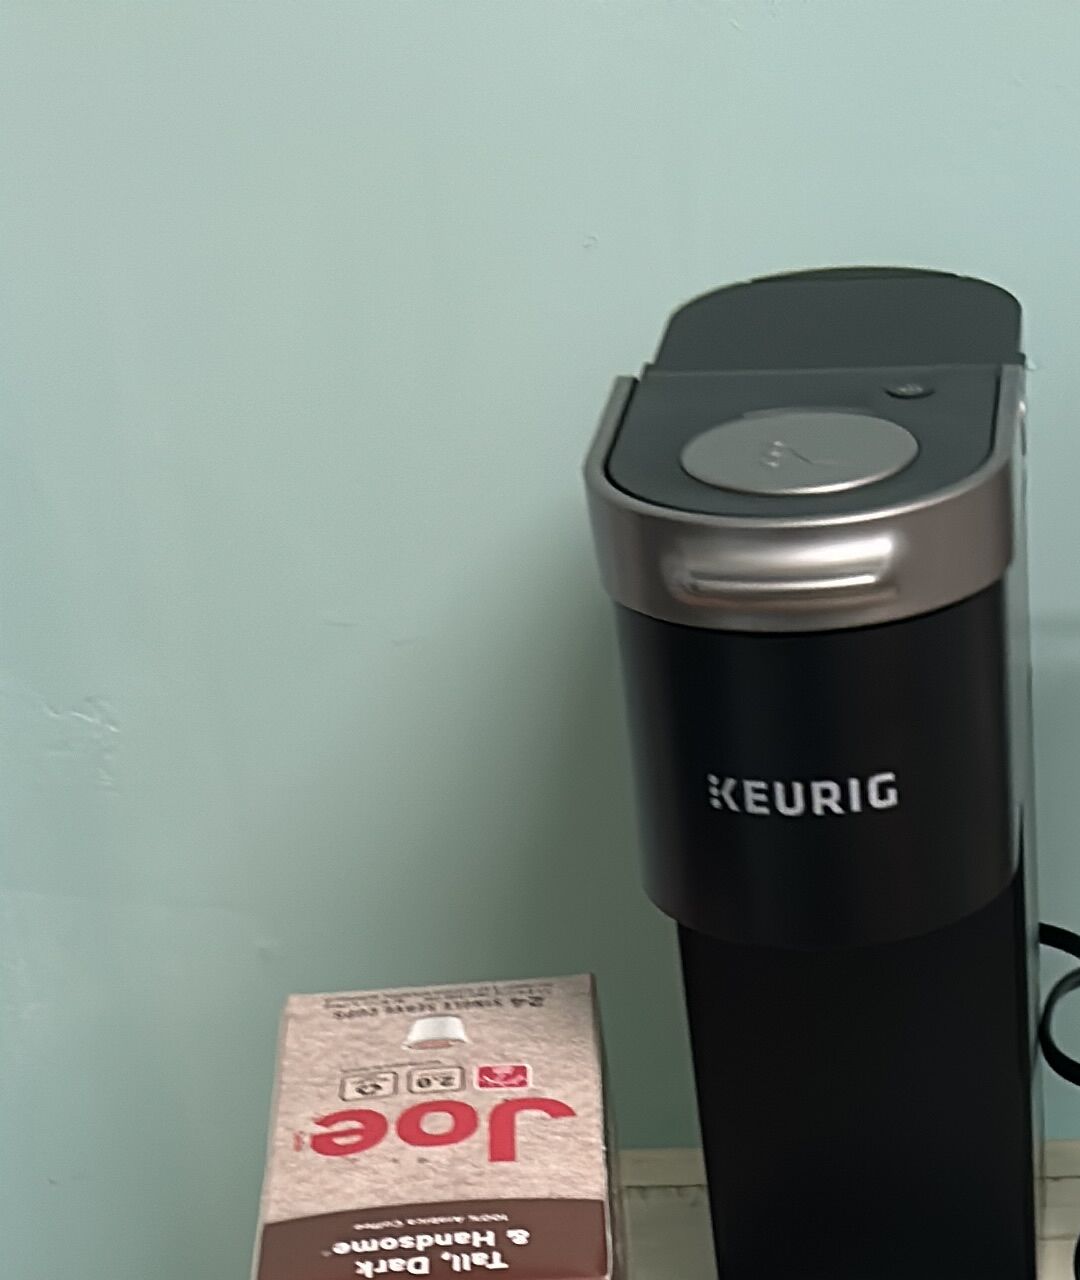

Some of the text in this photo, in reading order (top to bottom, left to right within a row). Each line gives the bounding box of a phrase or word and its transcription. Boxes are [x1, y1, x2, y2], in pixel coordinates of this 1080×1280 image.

[707, 772, 898, 816] KEURIG
[310, 1097, 577, 1162] Joe
[332, 1228, 531, 1255] & Handsome
[355, 1250, 509, 1279] Tall, Dark
